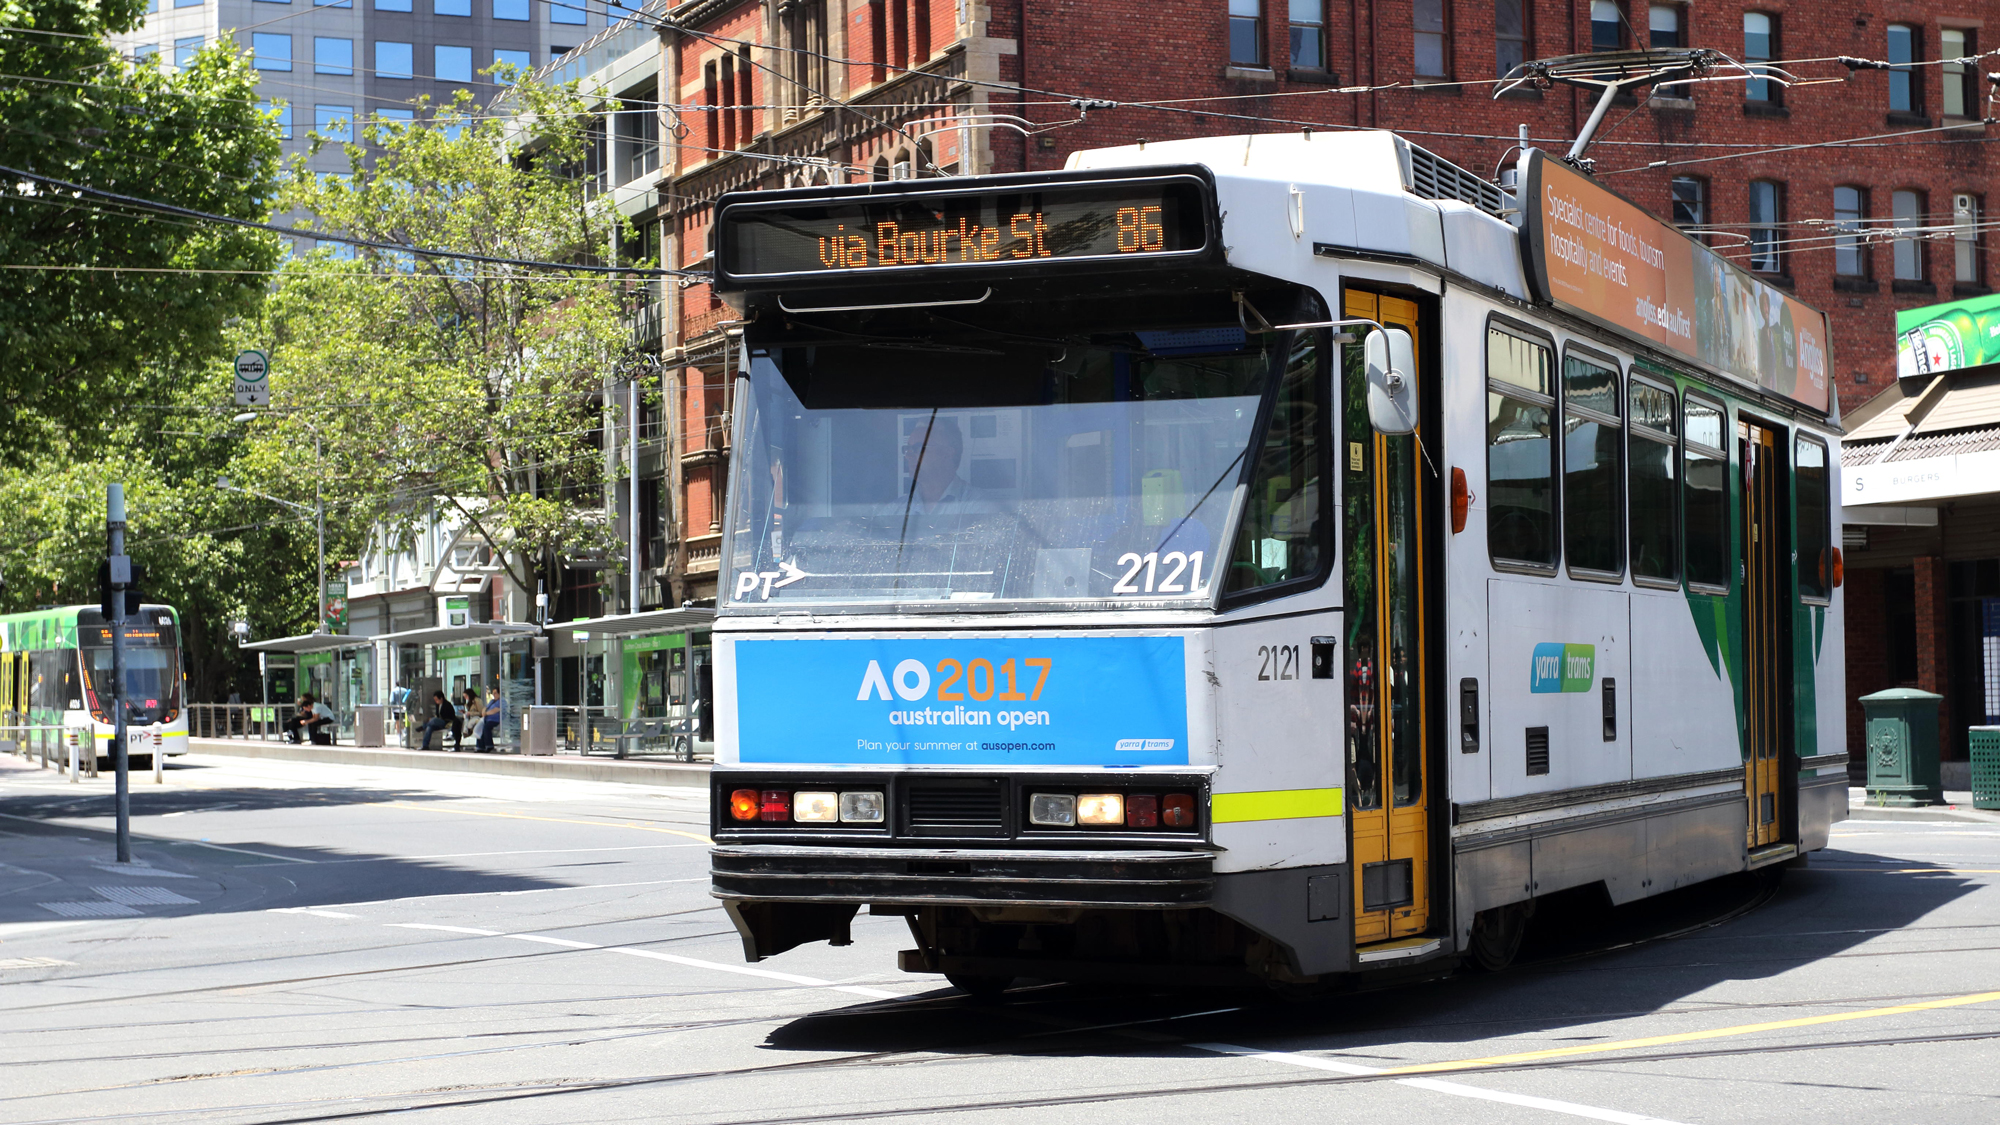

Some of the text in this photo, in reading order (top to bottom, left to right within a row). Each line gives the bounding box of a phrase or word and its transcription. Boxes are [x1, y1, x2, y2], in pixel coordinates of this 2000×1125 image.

[819, 212, 1051, 268] via Bourke St
[1117, 205, 1164, 253] 86
[1547, 184, 1665, 271] Specialist centre for foods, tourism
[1550, 223, 1588, 275] hospitality
[1589, 246, 1602, 276] and
[1604, 258, 1628, 288] events.
[1636, 295, 1691, 339] angliss.edu.au/first
[1800, 331, 1823, 380] Angliss
[237, 384, 266, 393] ONLY
[1893, 473, 1940, 485] BURGERS
[1112, 551, 1204, 594] 2121
[856, 657, 1052, 702] AO 2017
[1258, 645, 1299, 681] 2121
[1535, 652, 1591, 687] yarra trams
[889, 705, 1050, 731] australian open
[857, 739, 1056, 753] Plan your summer at ausopen.com
[1120, 740, 1169, 749] yarra trams
